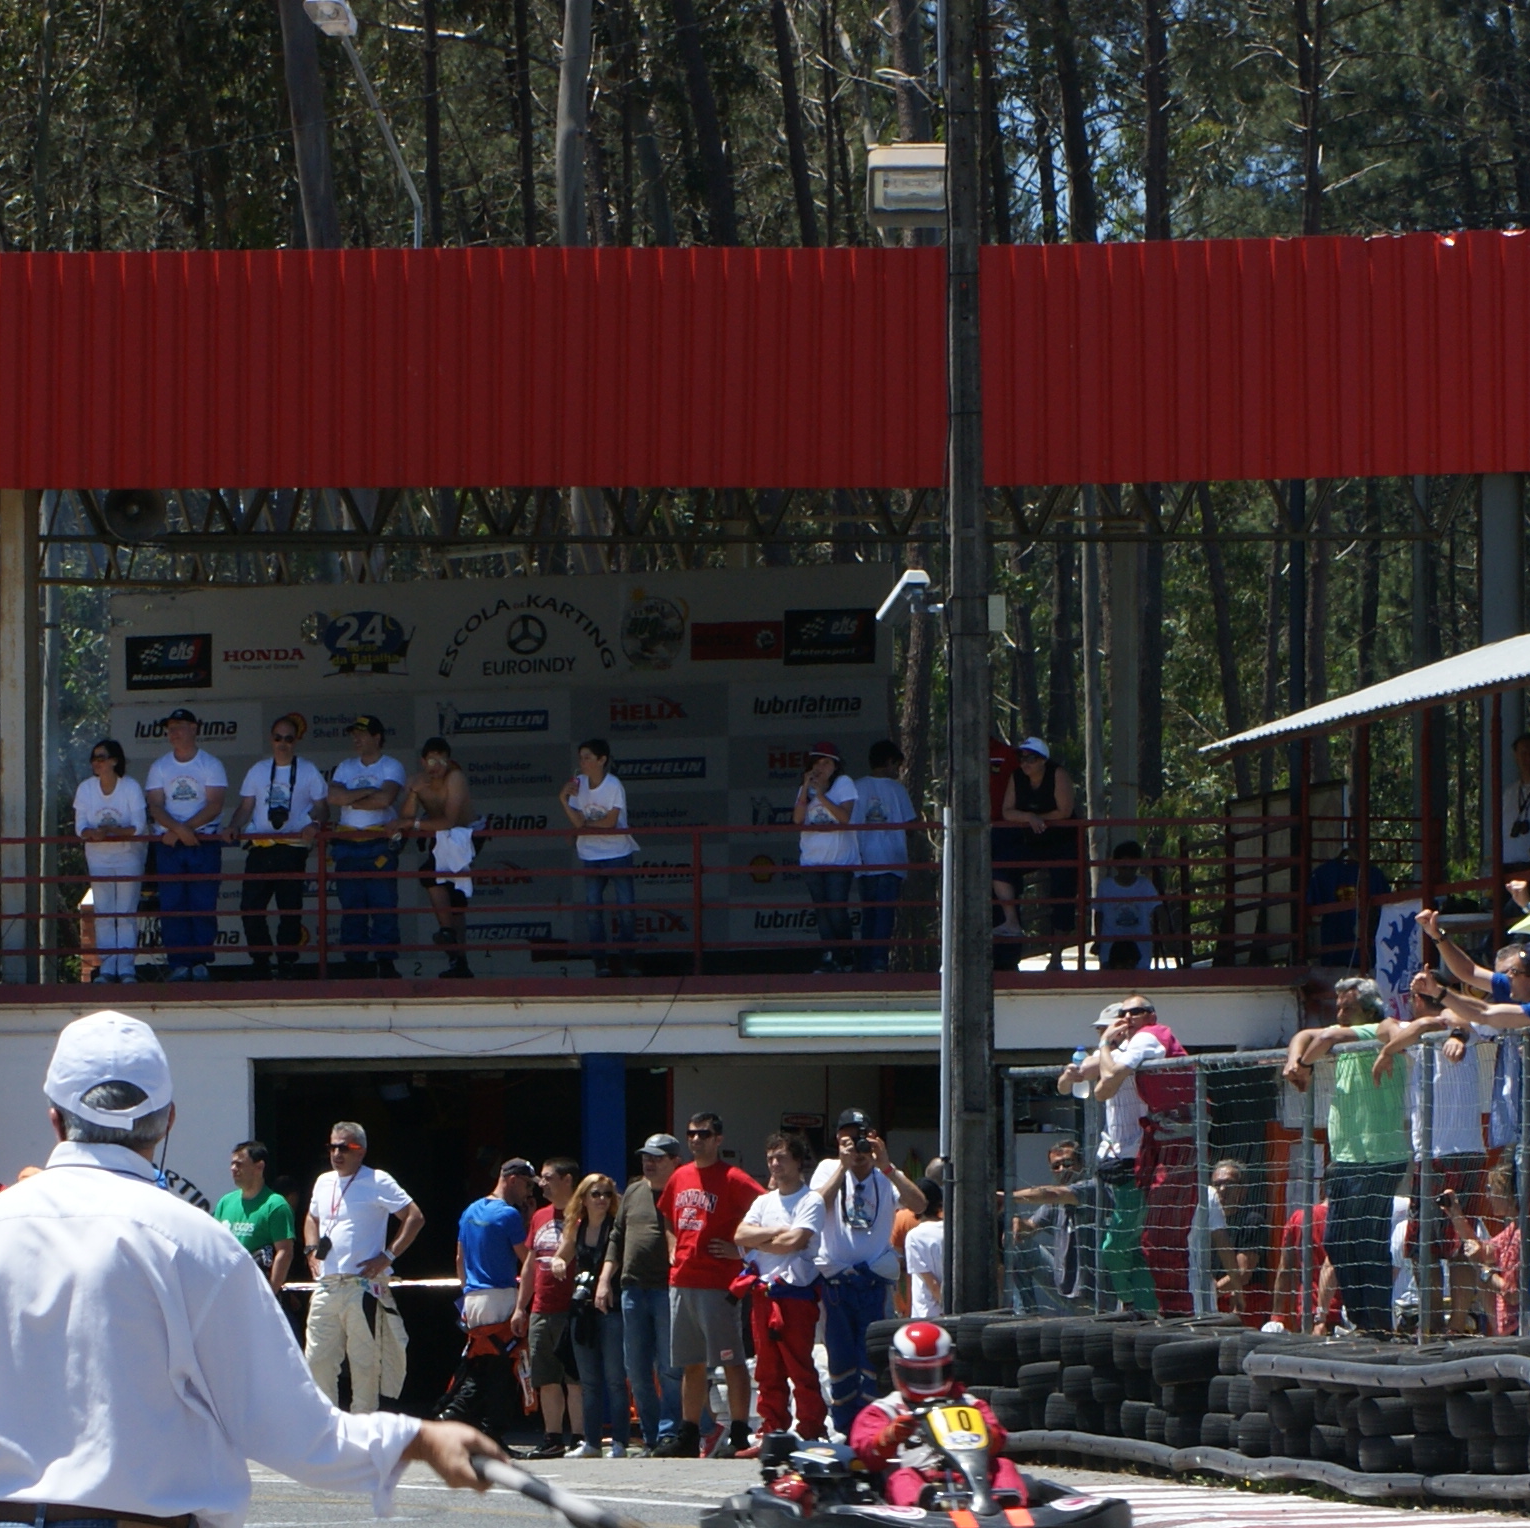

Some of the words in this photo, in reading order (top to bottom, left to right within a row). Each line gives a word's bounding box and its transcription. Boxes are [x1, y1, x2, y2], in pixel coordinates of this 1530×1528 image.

[335, 614, 386, 648] 24
[438, 598, 511, 678] ESCOLA
[526, 594, 617, 669] KARTING
[222, 648, 305, 662] HONDA
[789, 647, 857, 658] Motorsport
[482, 656, 576, 676] EUROINDY
[131, 671, 194, 682] Motorsport
[610, 702, 687, 721] HELIX
[753, 694, 862, 715] lubrifatima
[460, 713, 546, 729] MICHELIN
[620, 760, 704, 776] MICHELIN
